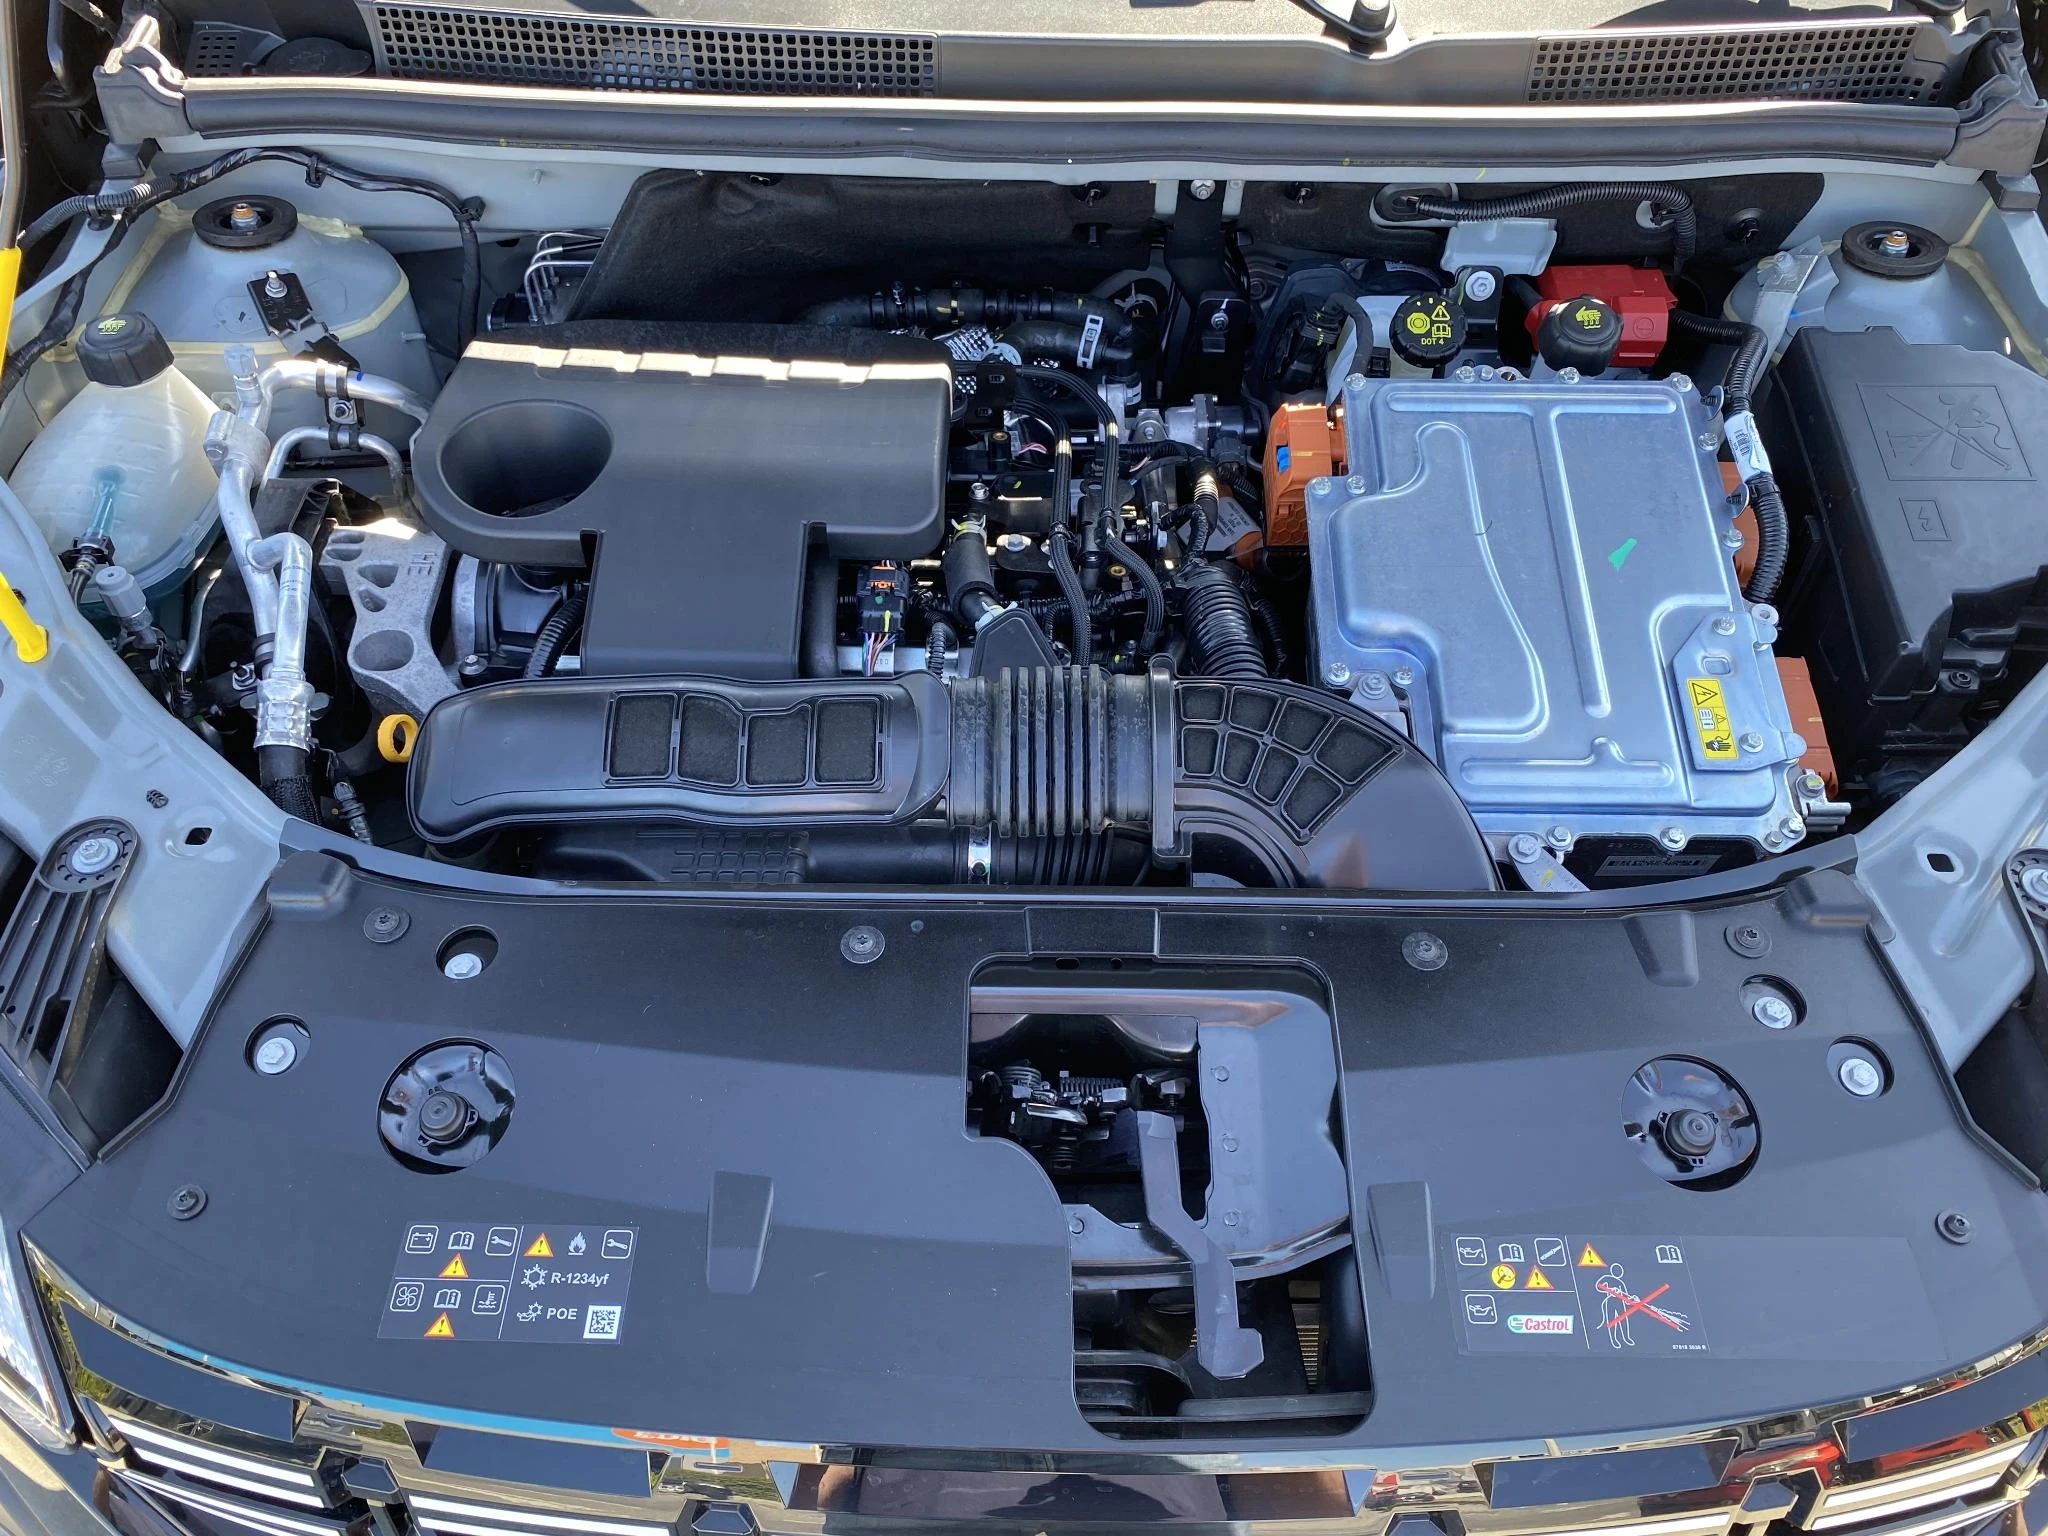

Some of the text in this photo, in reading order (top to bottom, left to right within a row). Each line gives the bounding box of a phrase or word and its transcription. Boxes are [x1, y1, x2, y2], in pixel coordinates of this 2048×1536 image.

[1421, 337, 1437, 345] DOT
[550, 1272, 610, 1288] R-1234yf
[546, 1307, 578, 1320] POE
[1525, 1318, 1570, 1331] Castrol
